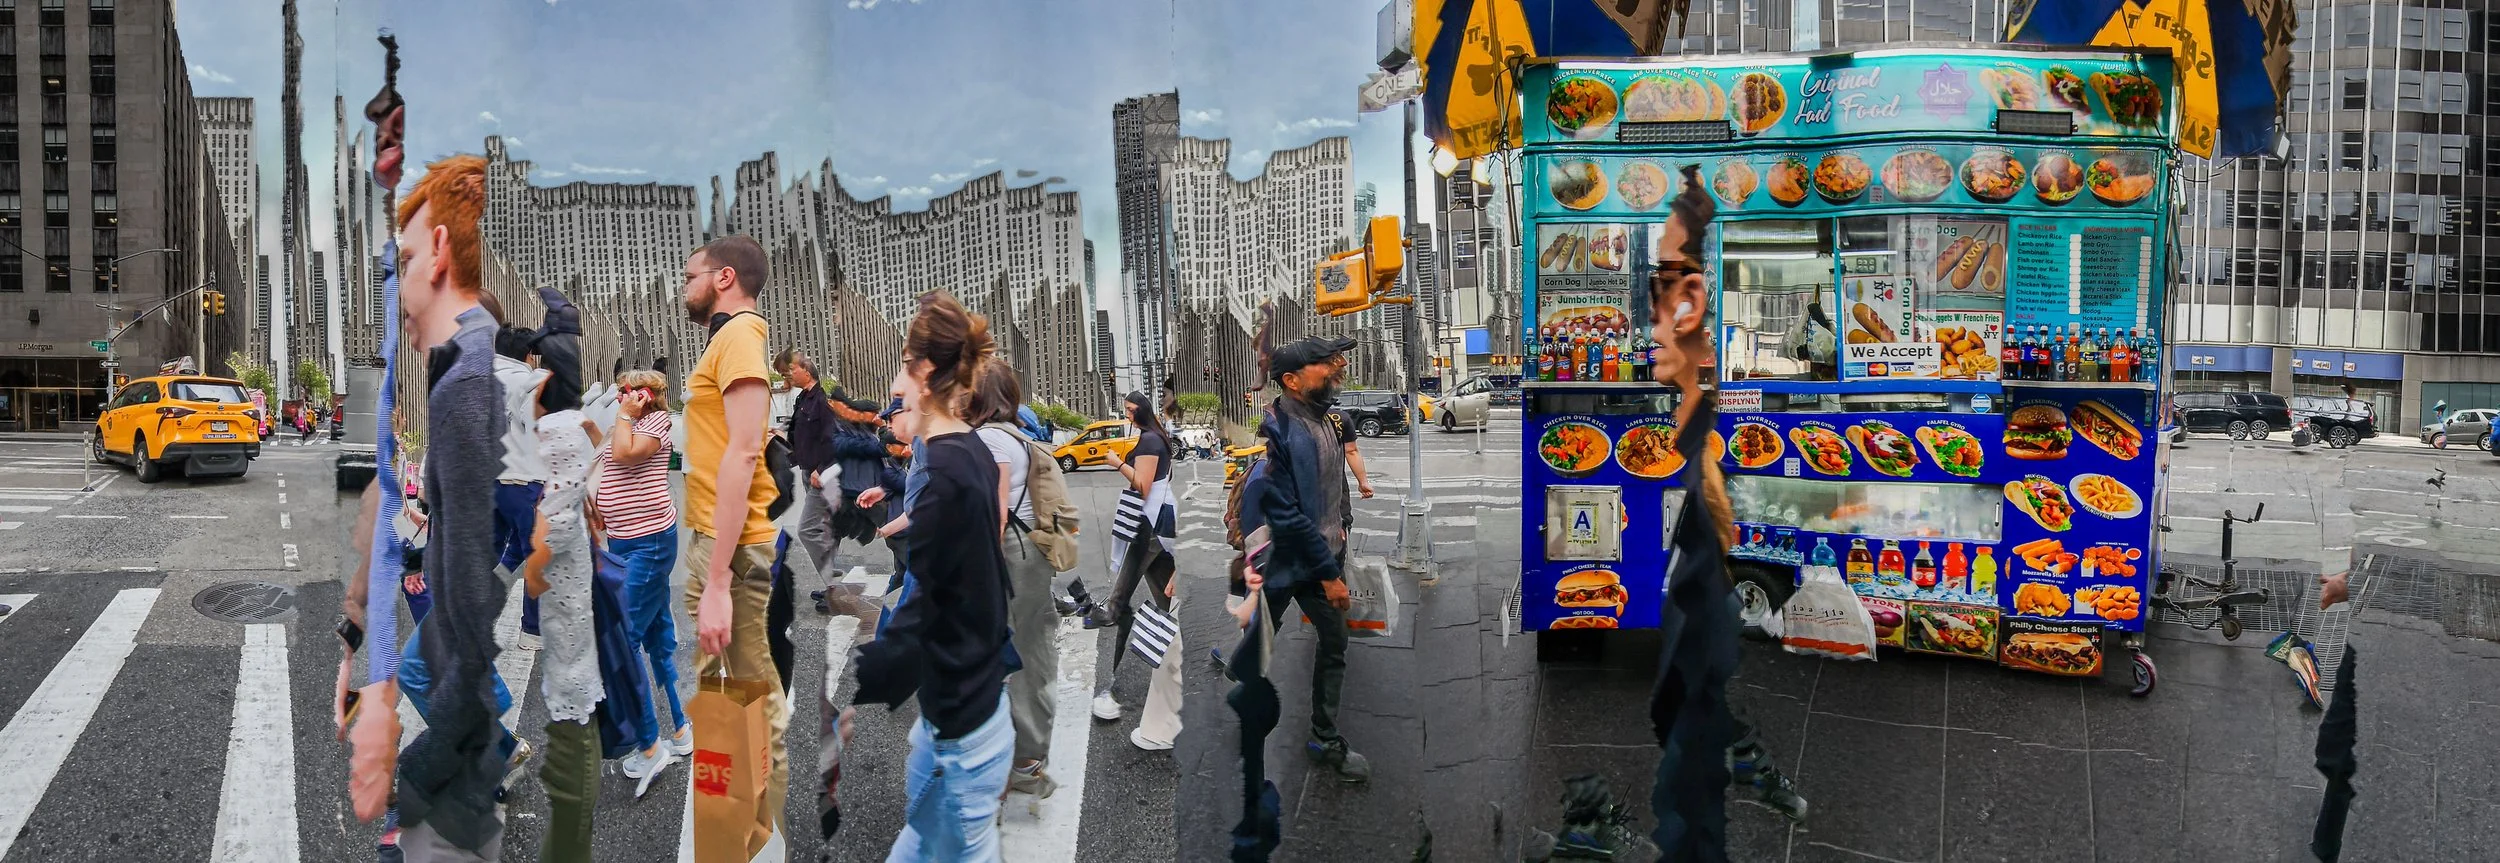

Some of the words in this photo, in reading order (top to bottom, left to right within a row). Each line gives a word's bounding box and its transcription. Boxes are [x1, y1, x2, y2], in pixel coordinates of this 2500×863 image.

[1376, 73, 1405, 99] ONE
[1839, 92, 1900, 123] Food
[1937, 224, 1957, 237] Dog
[1565, 279, 1581, 287] Dog
[1557, 296, 1588, 304] Jumbo
[1606, 296, 1622, 306] Dog
[1963, 313, 1984, 322] French
[1985, 314, 2000, 322] Fries
[1900, 312, 1912, 336] Dog
[1983, 331, 1999, 339] NY
[1851, 346, 1875, 358] We
[1879, 345, 1933, 359] Accept
[2056, 362, 2065, 373] G
[2067, 362, 2076, 374] G
[1543, 415, 1572, 430] CHICKEN
[1573, 415, 1591, 424] OVER
[1591, 419, 1608, 430] RICE
[1625, 418, 1643, 429] LAMB
[1573, 510, 1591, 529] A
[1562, 566, 1578, 575] PHILLY
[2022, 569, 2052, 577] Mozzarella
[1873, 598, 1903, 611] YORK
[2010, 622, 2033, 630] Philly
[2035, 624, 2069, 633] Cheese
